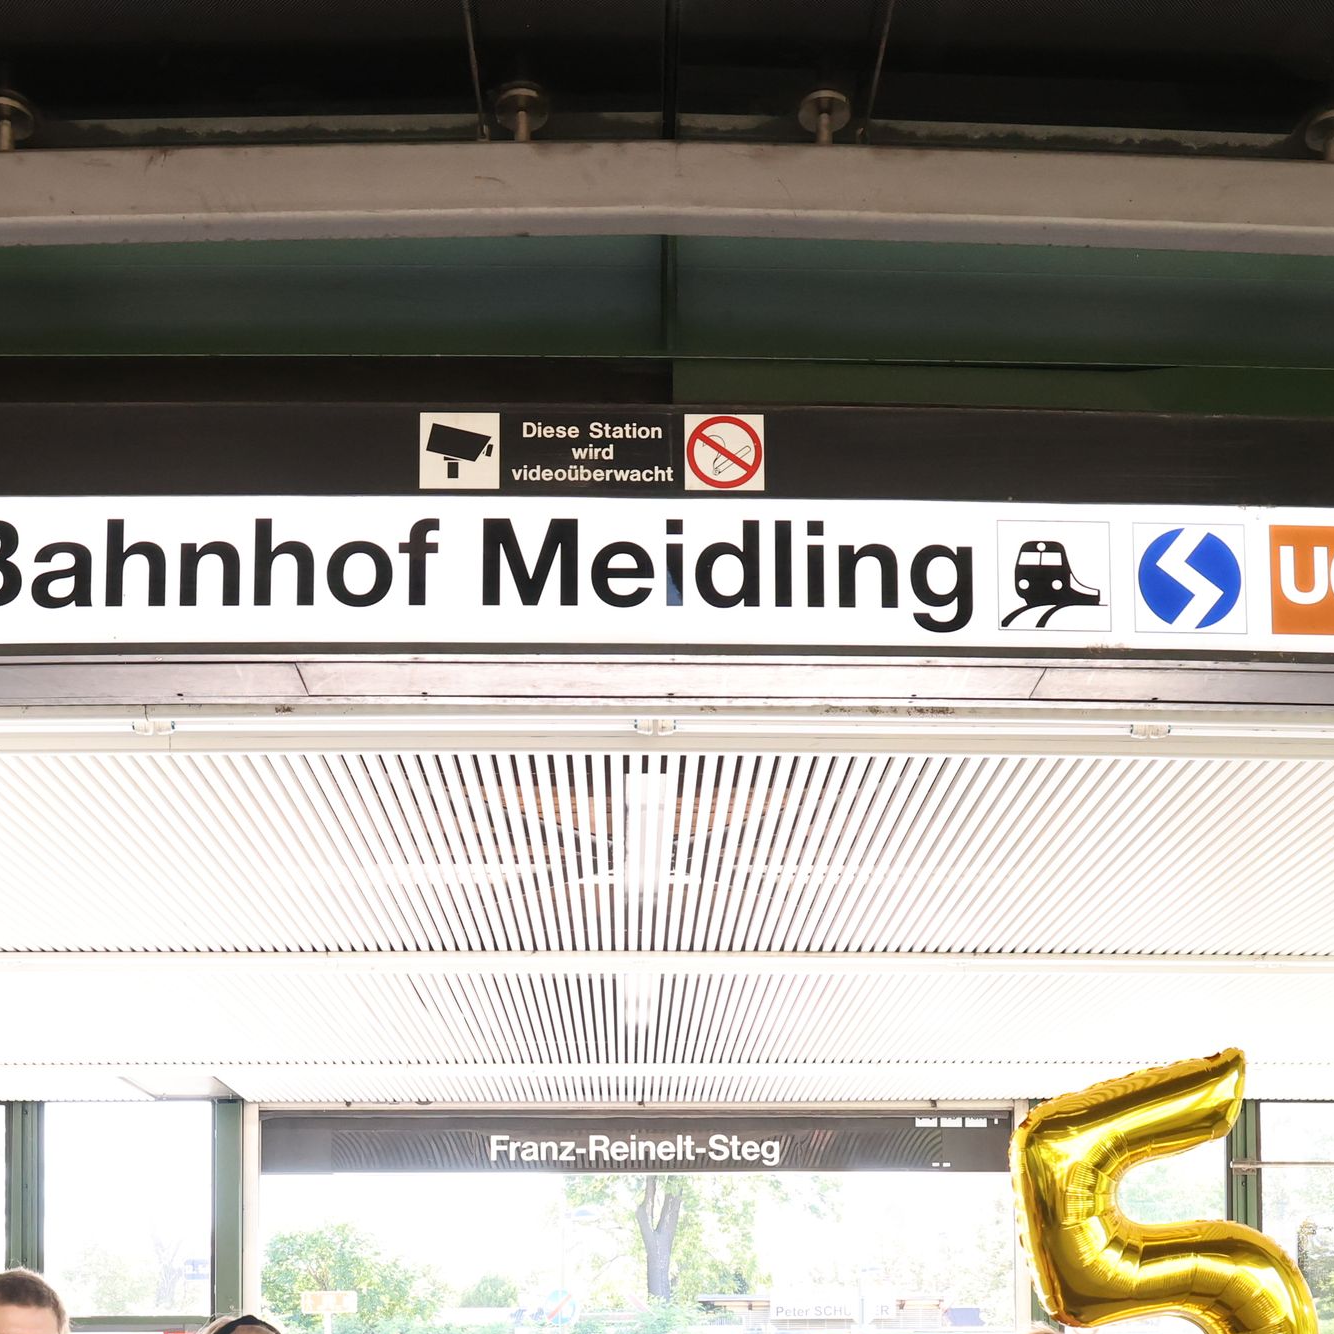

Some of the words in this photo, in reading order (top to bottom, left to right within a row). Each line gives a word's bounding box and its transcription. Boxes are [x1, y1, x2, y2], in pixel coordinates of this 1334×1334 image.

[522, 421, 579, 439] Diese
[589, 421, 663, 439] Station
[572, 444, 614, 460] wird
[512, 466, 674, 482] videoüberwacht
[482, 518, 973, 633] Meidling
[489, 1134, 780, 1166] Franz-Reinelt-Steg
[776, 1306, 810, 1317] Peter
